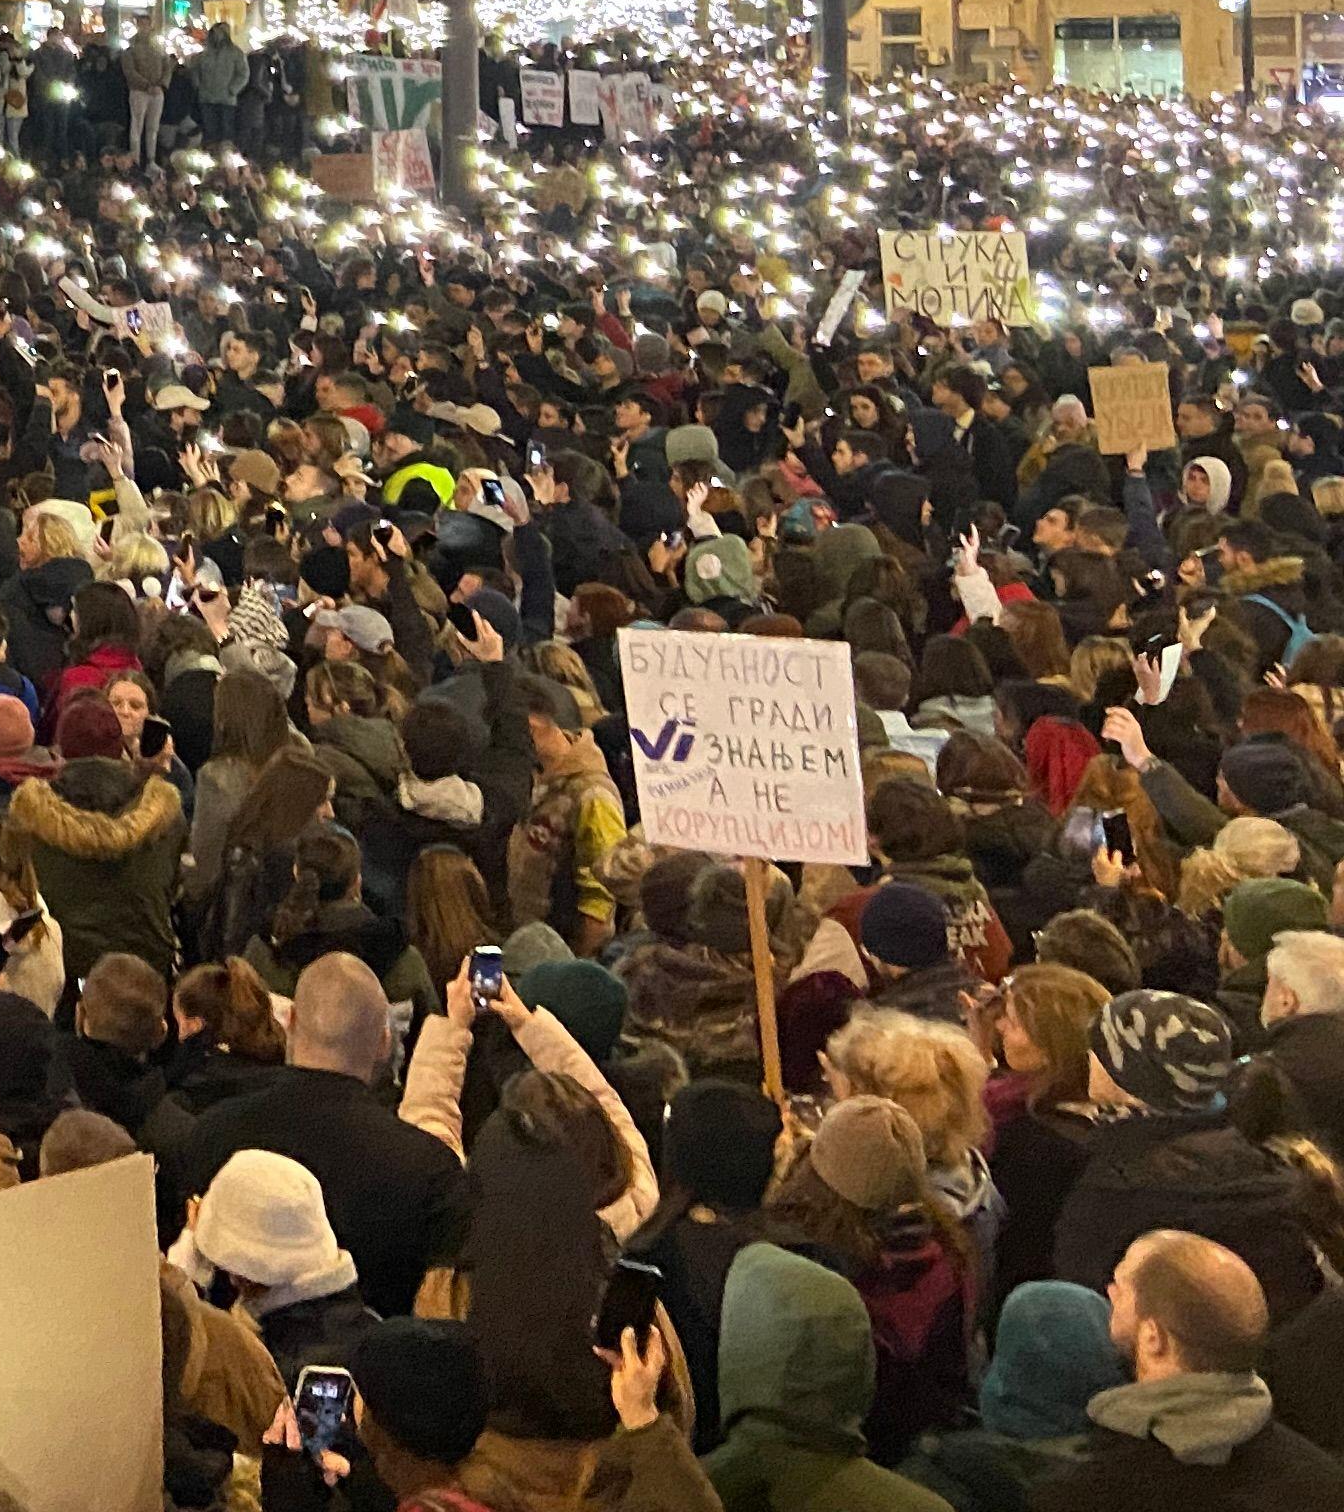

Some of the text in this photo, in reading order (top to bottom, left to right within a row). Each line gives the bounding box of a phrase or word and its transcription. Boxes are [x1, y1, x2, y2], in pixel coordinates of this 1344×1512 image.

[893, 231, 1015, 263] СТРУКА
[945, 262, 968, 284] И
[891, 285, 1031, 321] МОТИКА
[628, 641, 832, 690] БУДУЋНОСТ
[728, 696, 833, 734] ГРАДИ
[703, 732, 855, 779] ЗНАЊЕМ
[708, 775, 793, 814] А НЕ
